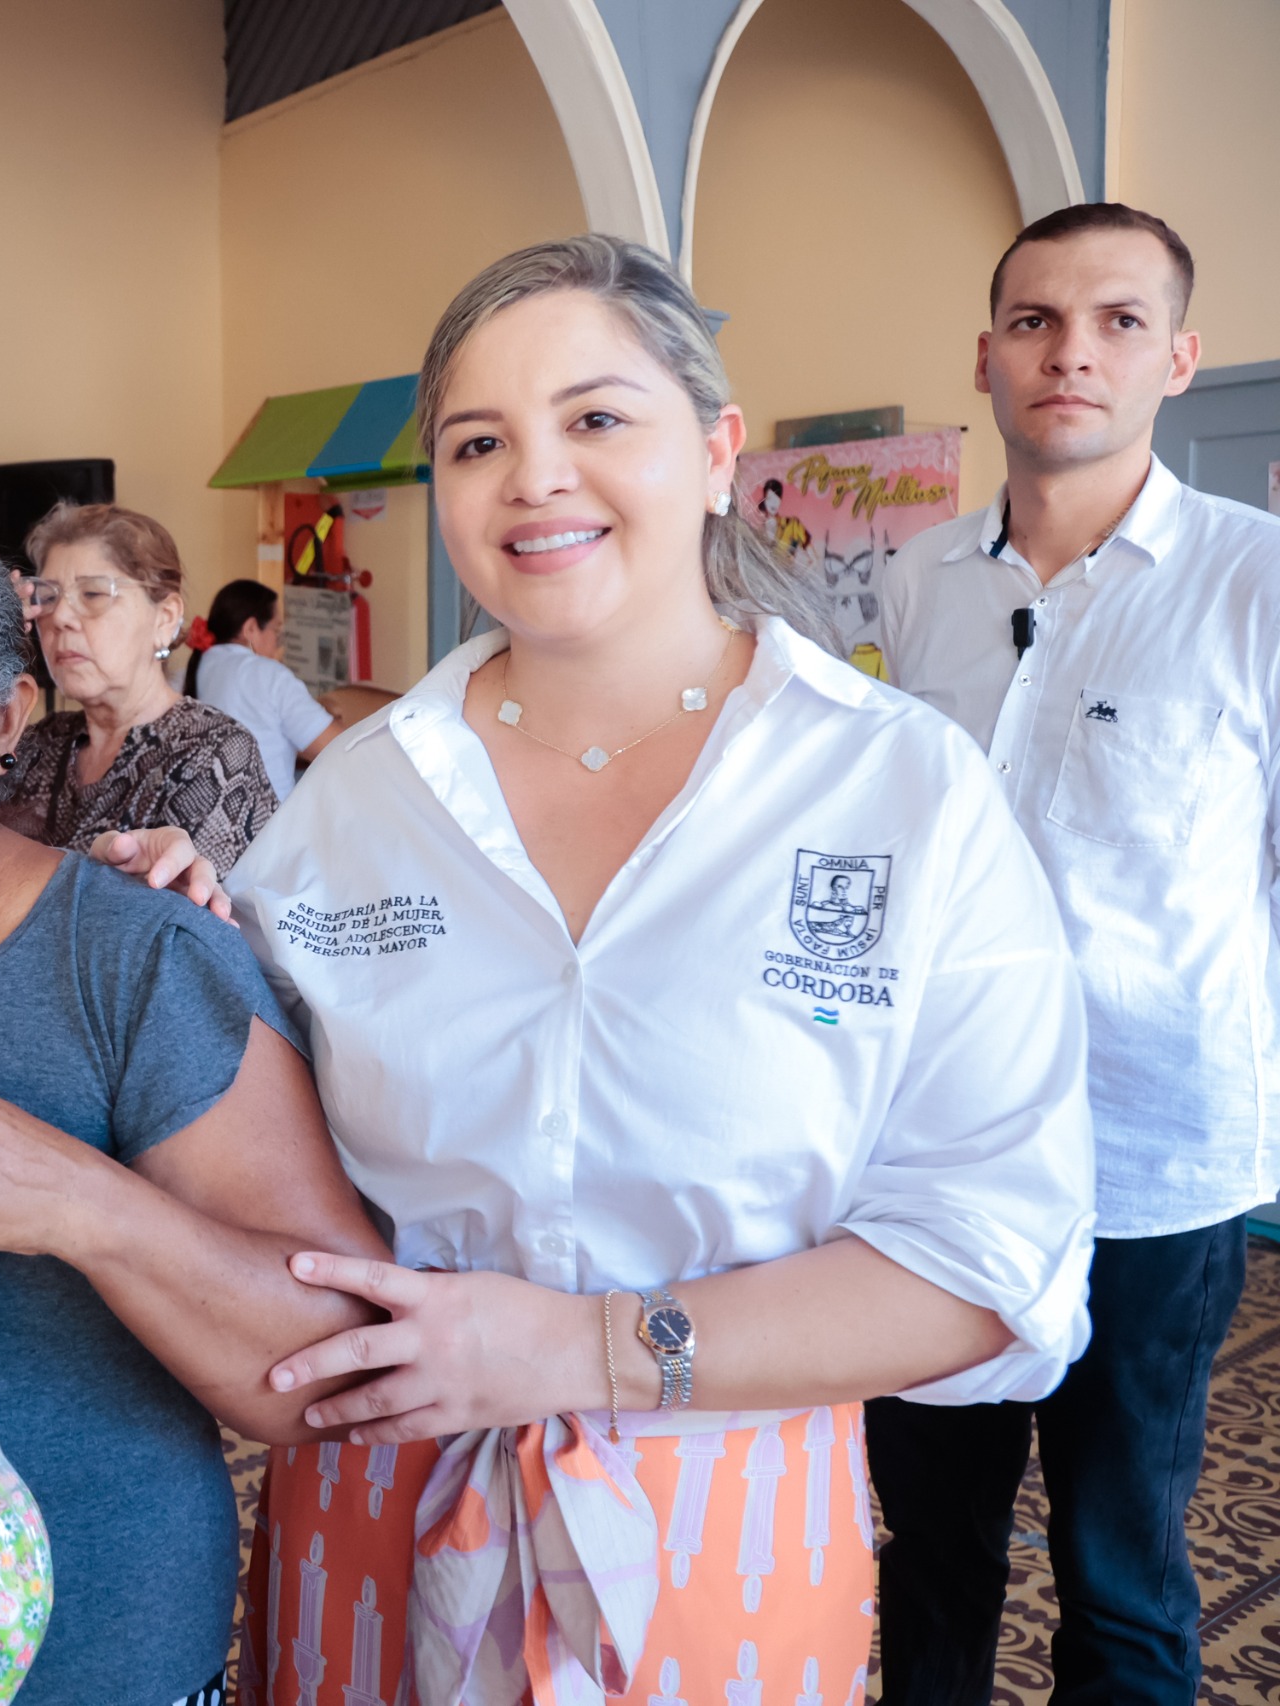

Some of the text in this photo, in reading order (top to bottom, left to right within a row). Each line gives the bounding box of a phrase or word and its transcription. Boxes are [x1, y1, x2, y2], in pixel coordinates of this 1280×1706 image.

[818, 857, 869, 870] OMNIA
[795, 874, 810, 907] SUNT
[872, 885, 886, 911] PER
[287, 909, 445, 933] EQUIDAD DE LA MUJER,
[297, 895, 439, 922] SECRETARÍA PARA LA
[277, 919, 446, 946] INFANCIA ADOLESCENCIA
[288, 934, 428, 957] Y PERSONA MAYOR
[836, 927, 878, 958] IPSUM
[764, 950, 899, 981] GOBERNACIÓN DE
[763, 967, 894, 1007] CÓRDOBA
